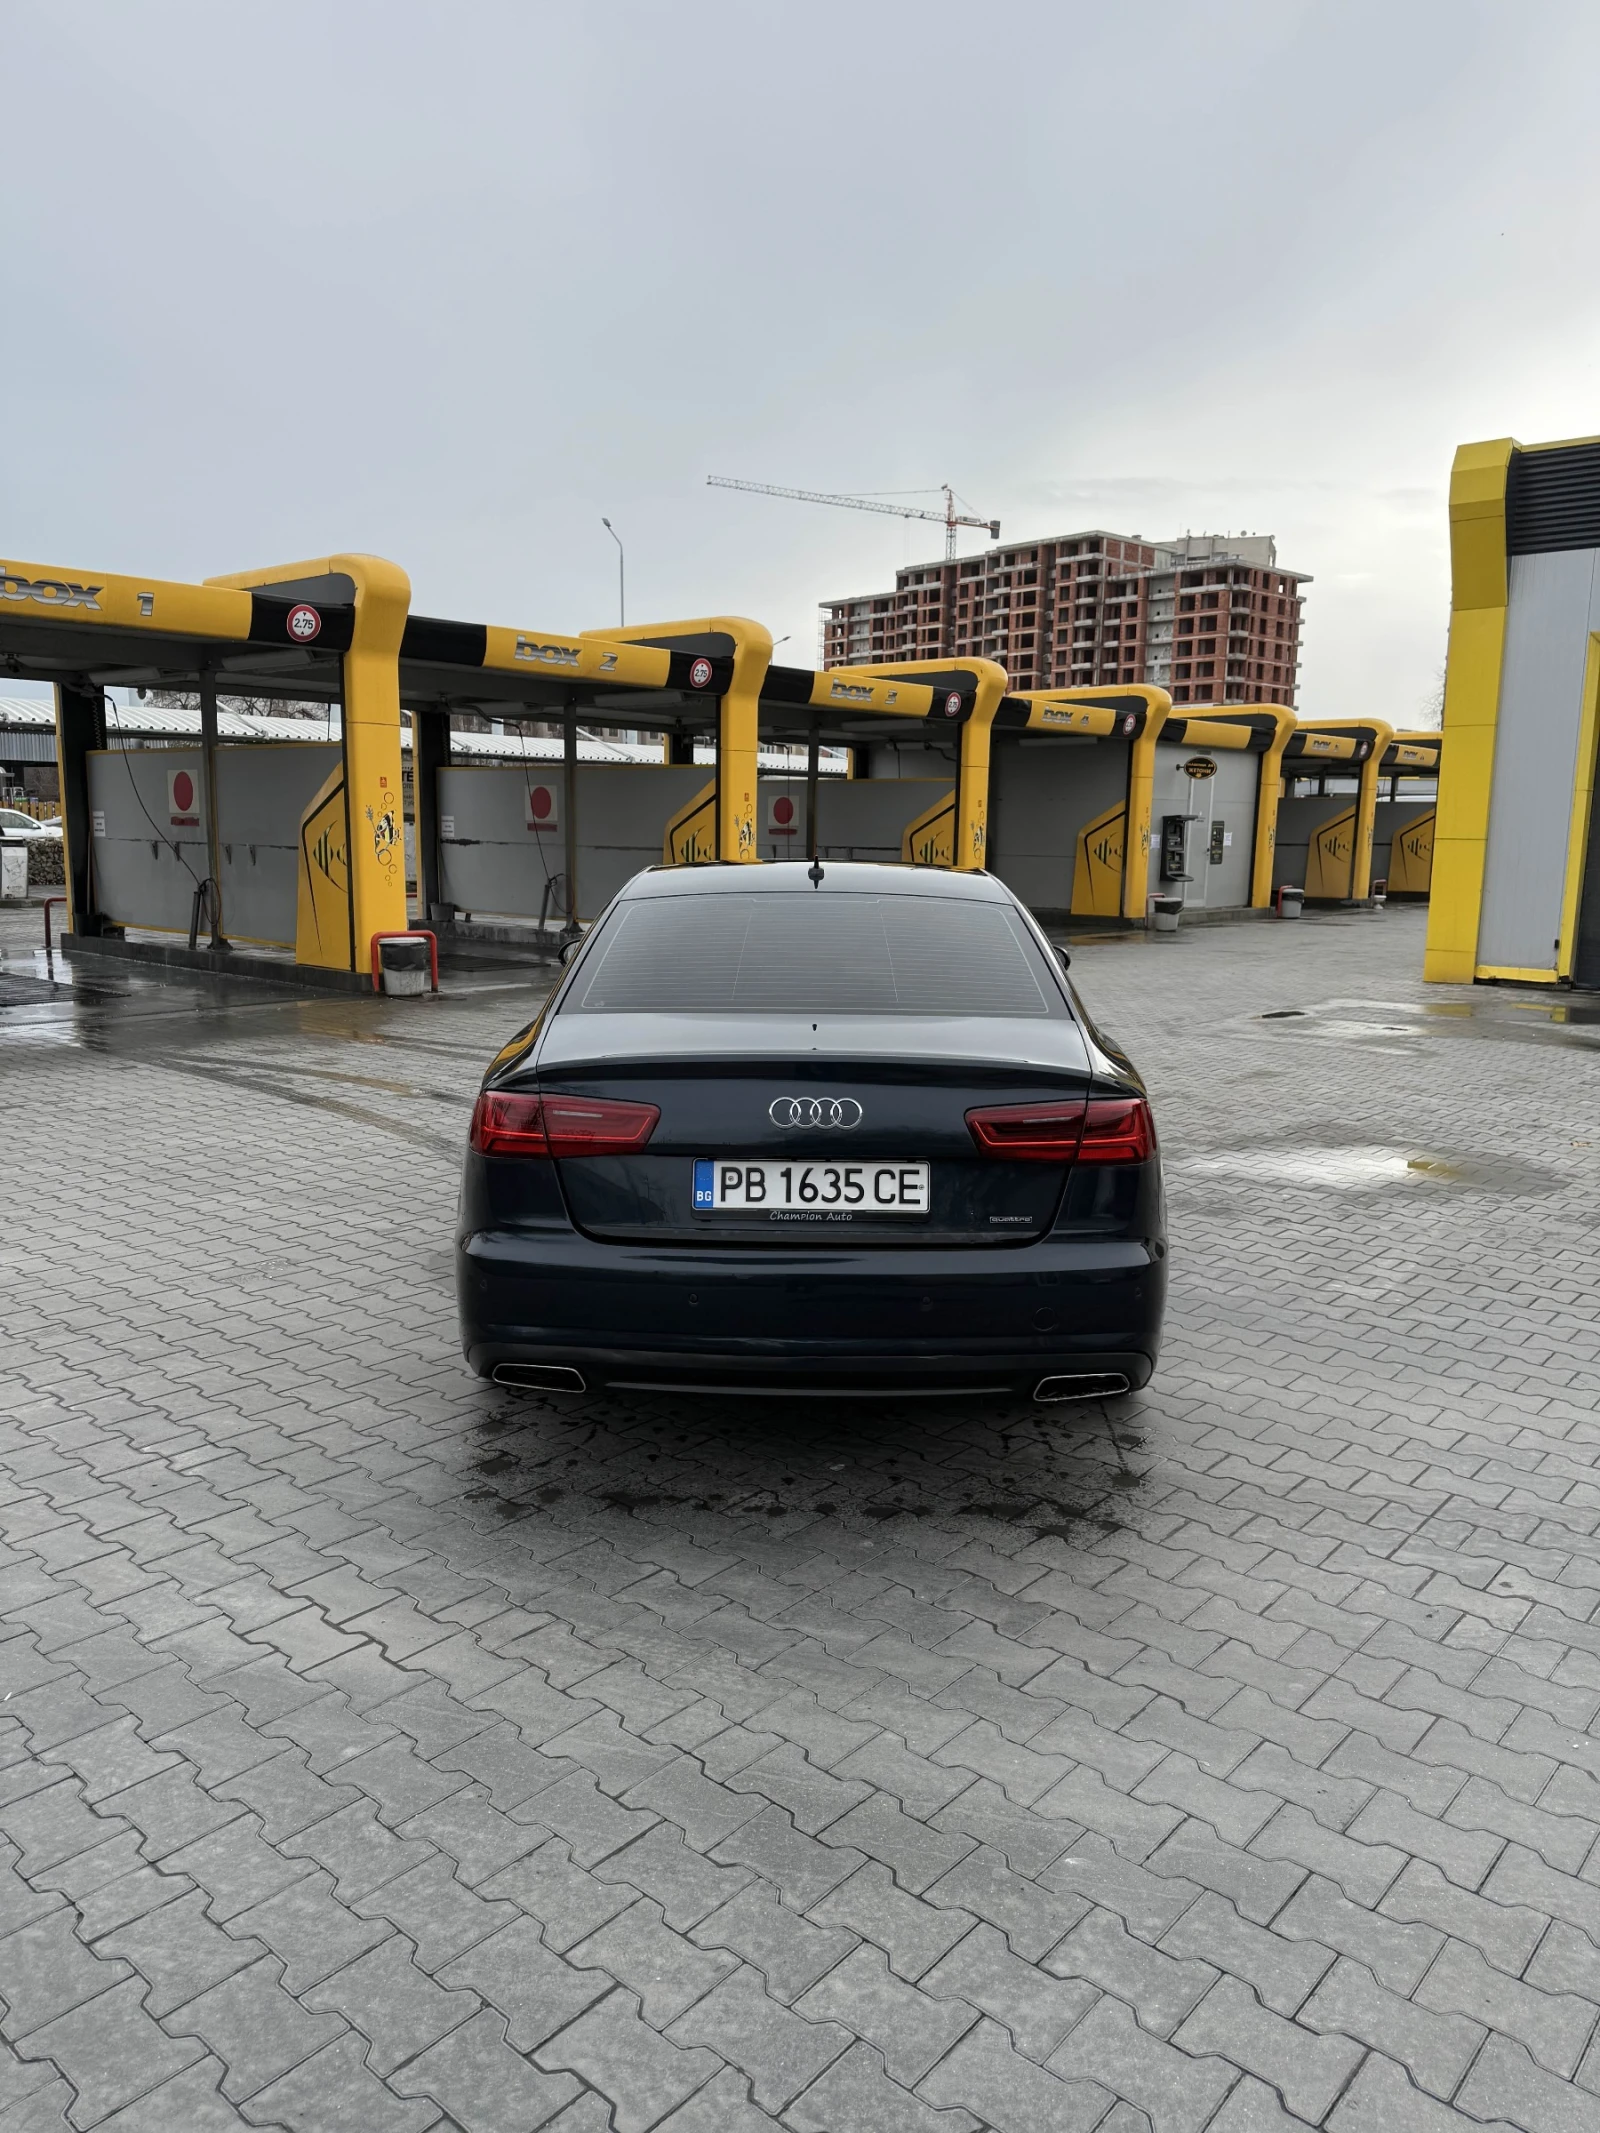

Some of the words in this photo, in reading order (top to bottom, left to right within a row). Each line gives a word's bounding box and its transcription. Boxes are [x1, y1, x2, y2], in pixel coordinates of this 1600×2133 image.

[0, 565, 104, 611] box
[137, 591, 155, 617] 1
[294, 618, 314, 630] 2.75
[514, 634, 582, 667] box
[599, 652, 619, 672] 2
[694, 668, 708, 678] 2.75
[830, 678, 875, 702] box
[885, 689, 898, 705] 3
[720, 1166, 766, 1203] PB
[780, 1167, 865, 1204] 1635
[874, 1168, 921, 1205] CE
[696, 1190, 712, 1202] BG
[769, 1210, 823, 1222] Champion
[826, 1211, 853, 1222] Auto
